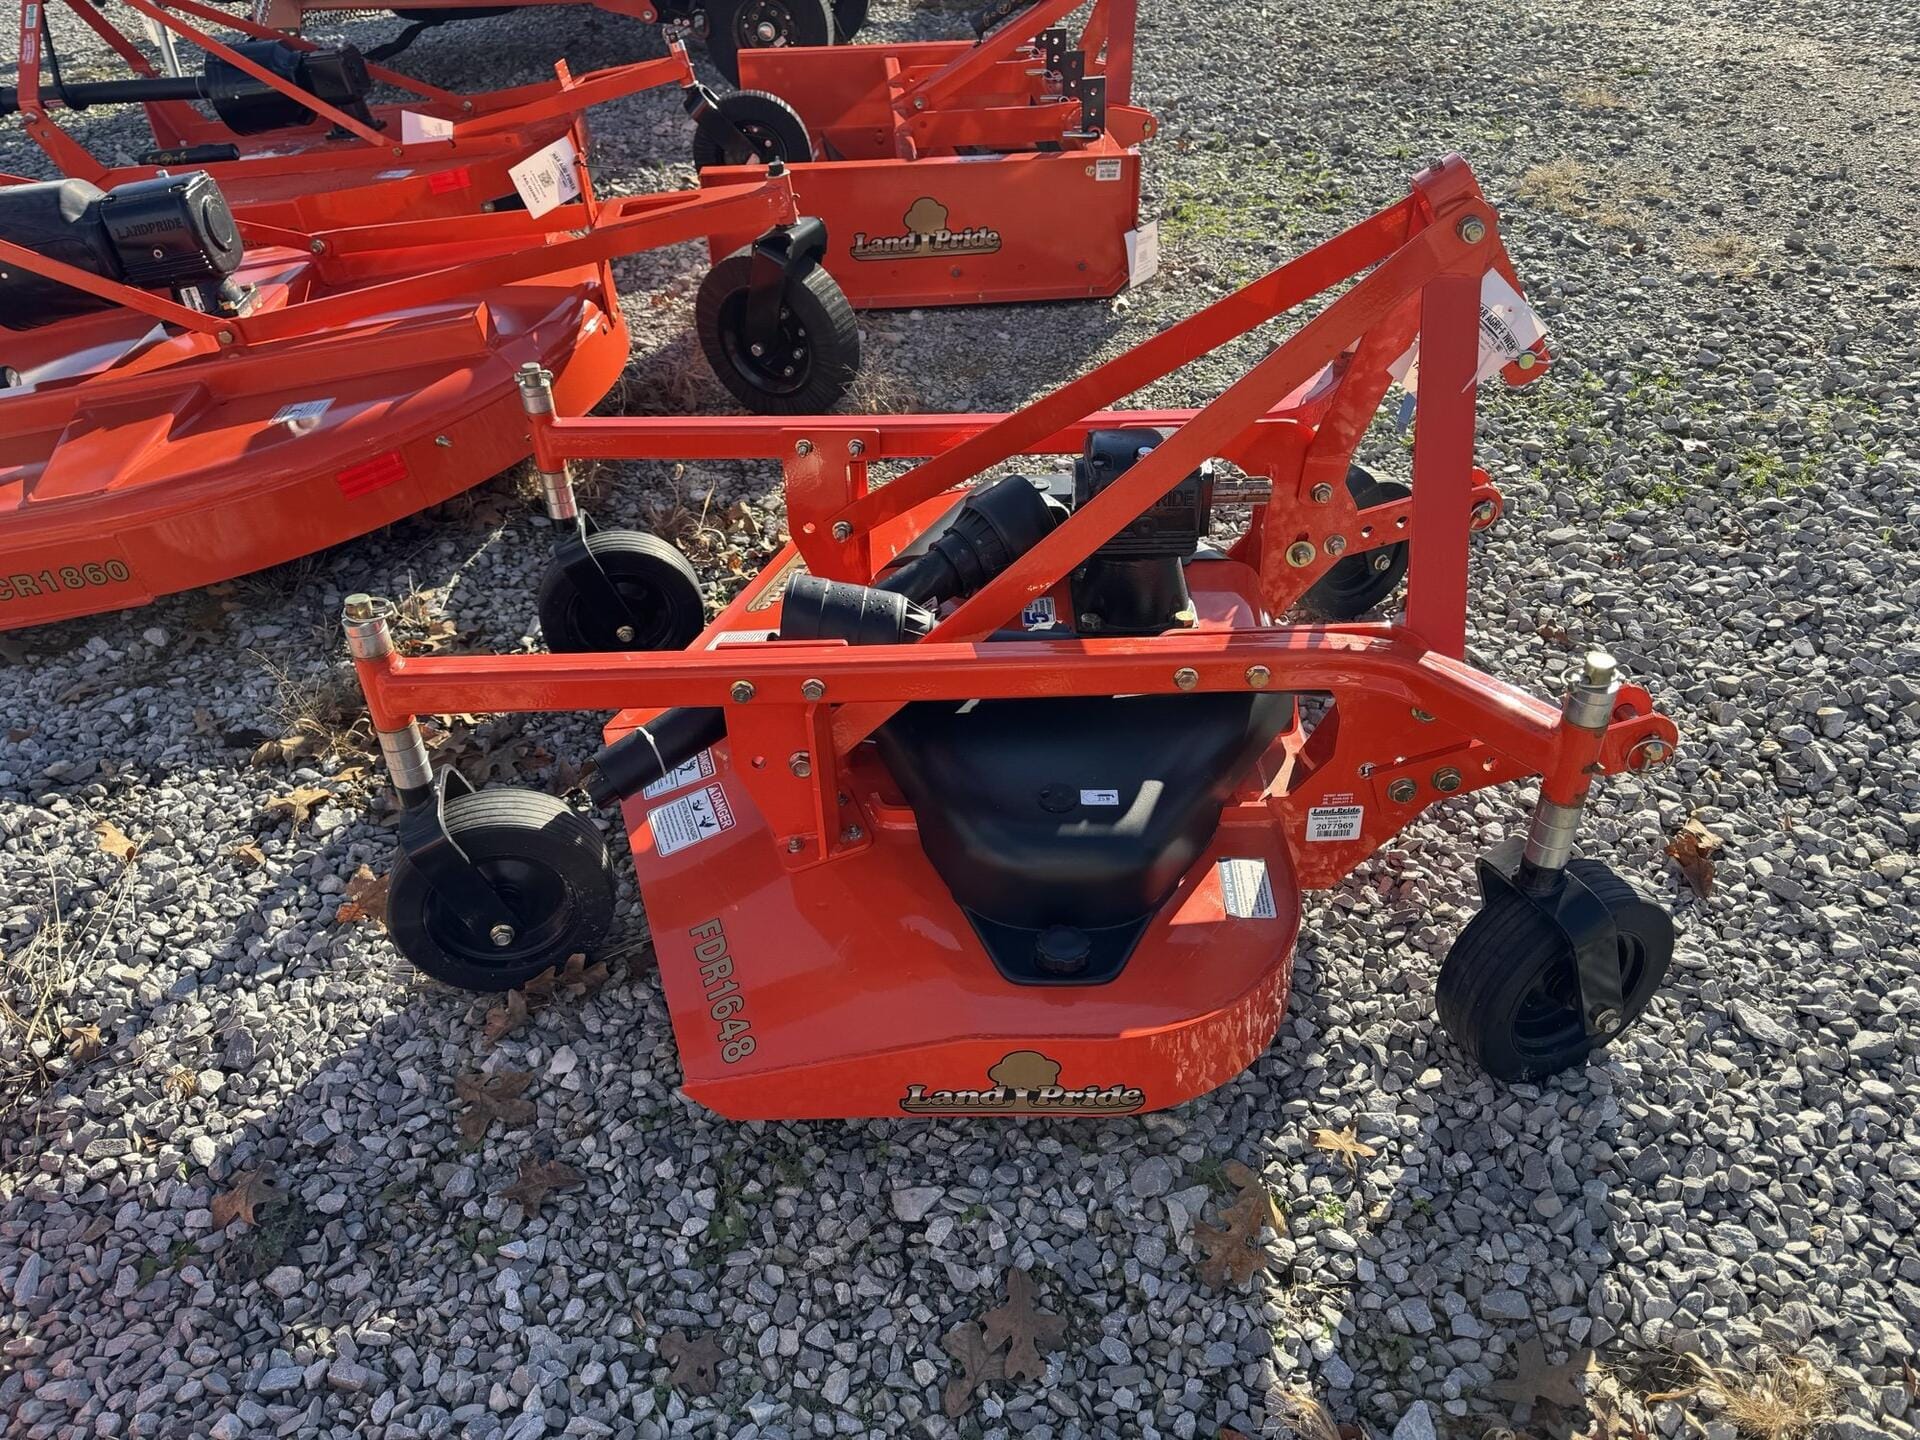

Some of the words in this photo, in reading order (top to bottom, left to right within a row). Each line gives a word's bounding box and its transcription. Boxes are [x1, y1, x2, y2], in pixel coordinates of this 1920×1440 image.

[853, 231, 917, 254] Land
[932, 227, 1000, 251] Pride
[711, 792, 733, 829] DANGER
[1315, 822, 1354, 830] 2077969
[1225, 882, 1233, 892] TO
[1226, 892, 1237, 914] NOTICE
[689, 917, 757, 1064] FDR1648
[902, 1084, 1008, 1107] Land
[1033, 1084, 1145, 1107] Pride
